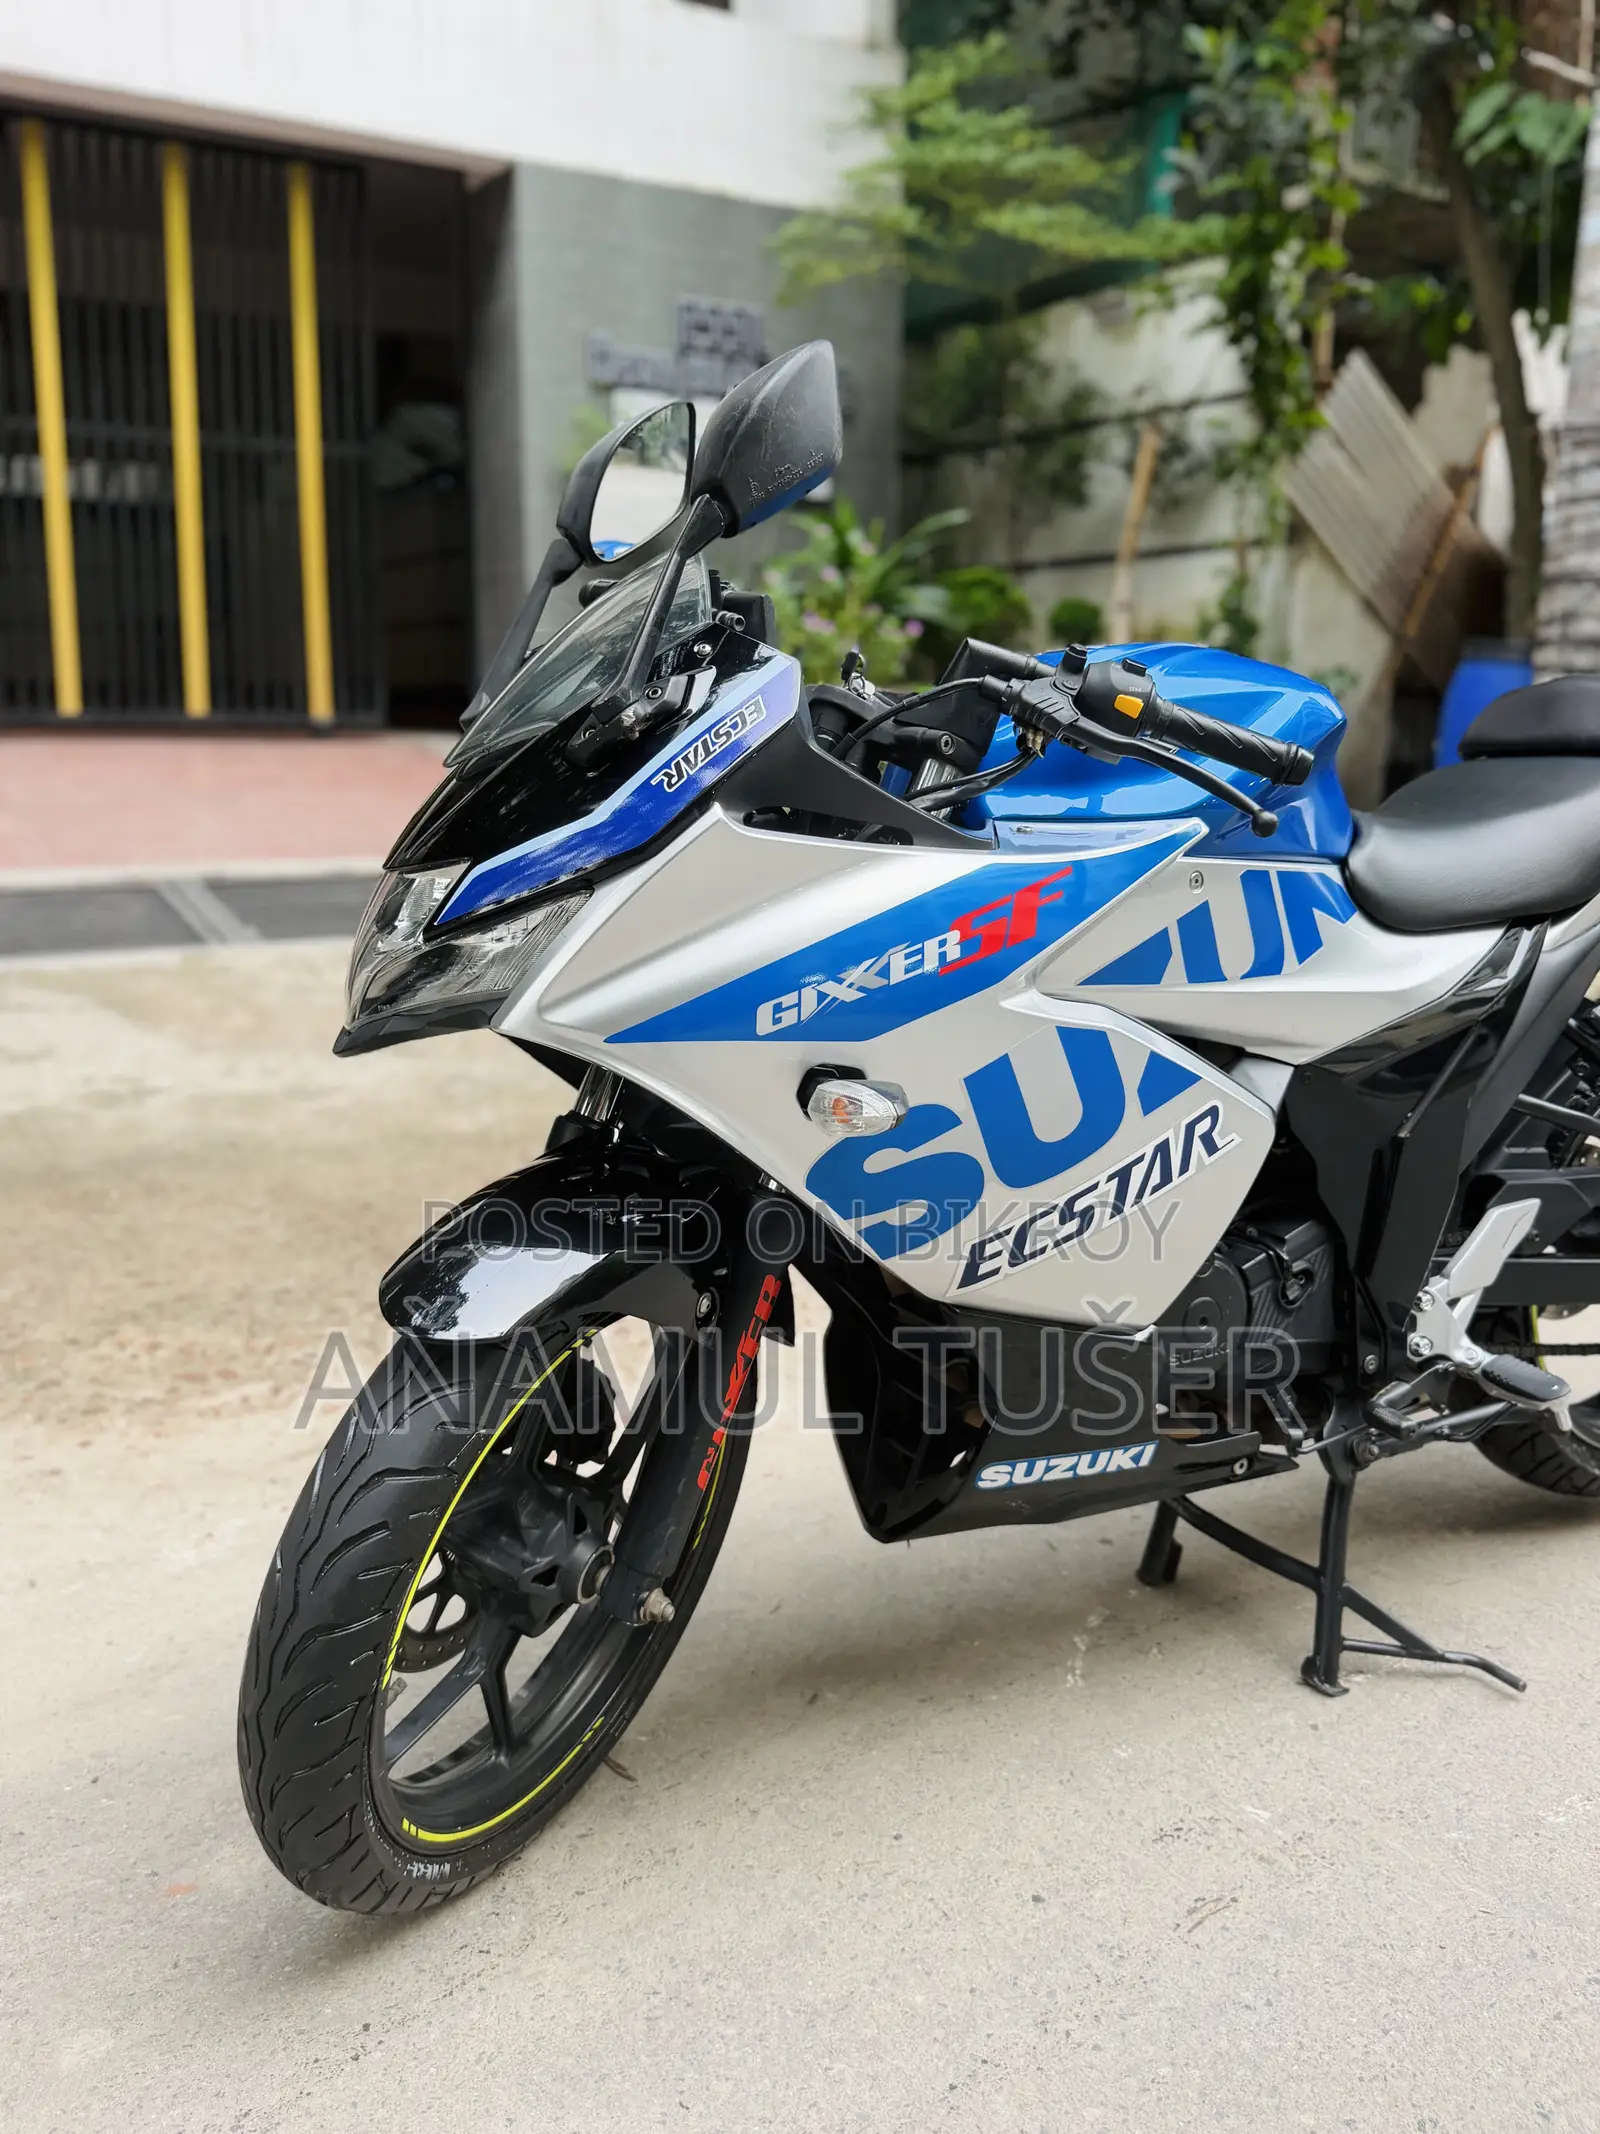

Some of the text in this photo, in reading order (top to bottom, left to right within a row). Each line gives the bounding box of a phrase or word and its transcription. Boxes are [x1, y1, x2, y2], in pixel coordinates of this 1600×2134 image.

[650, 695, 766, 792] ECSTAR
[755, 929, 961, 1036] GIXXER
[939, 866, 1073, 977] SF
[950, 1101, 1239, 1292] ECSTAR
[976, 1442, 1157, 1490] SUZUKI
